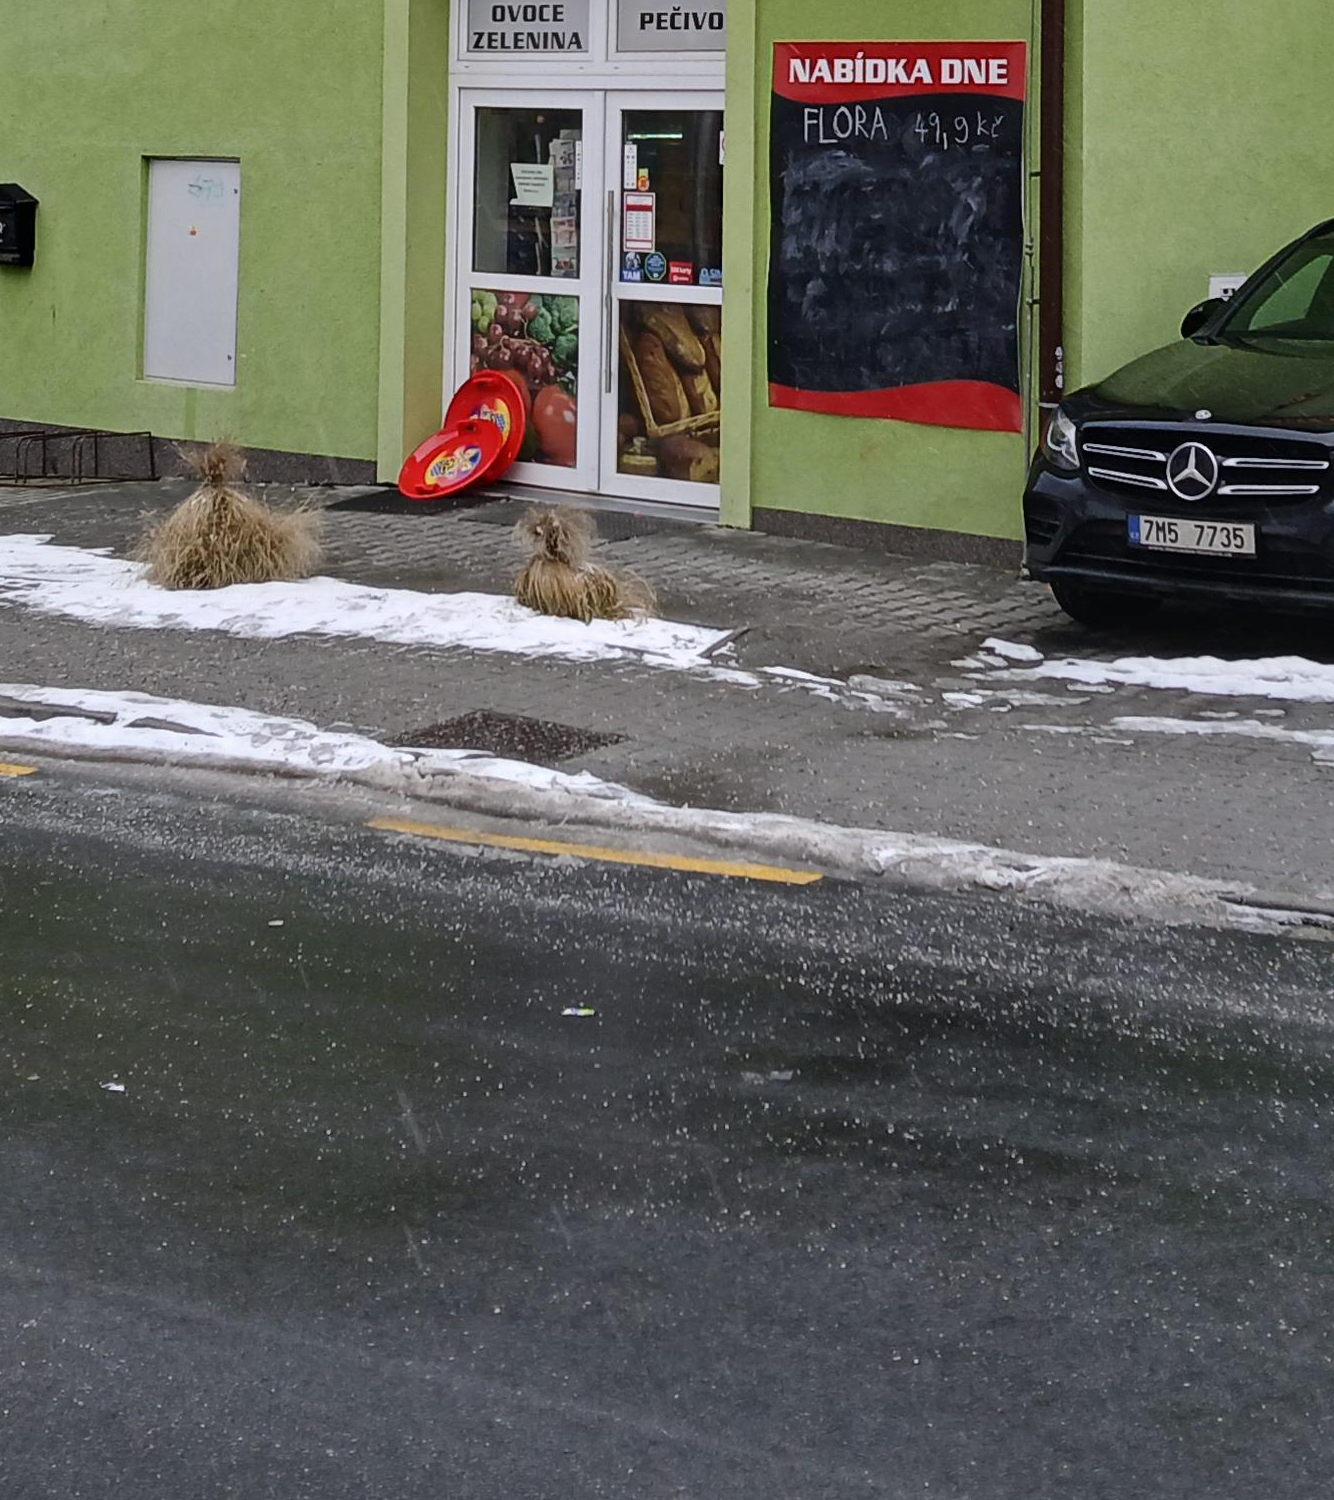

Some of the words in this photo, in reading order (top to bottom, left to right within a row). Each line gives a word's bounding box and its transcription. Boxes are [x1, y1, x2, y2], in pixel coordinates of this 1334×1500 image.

[491, 4, 564, 22] OVOCE
[639, 6, 724, 30] PEČIVO
[472, 32, 583, 50] ZELENINA
[788, 52, 933, 84] NABÍDKA
[940, 58, 1009, 84] DNE
[803, 104, 889, 144] FLORA
[1143, 519, 1179, 544] 7M5
[1194, 524, 1245, 549] 7735
